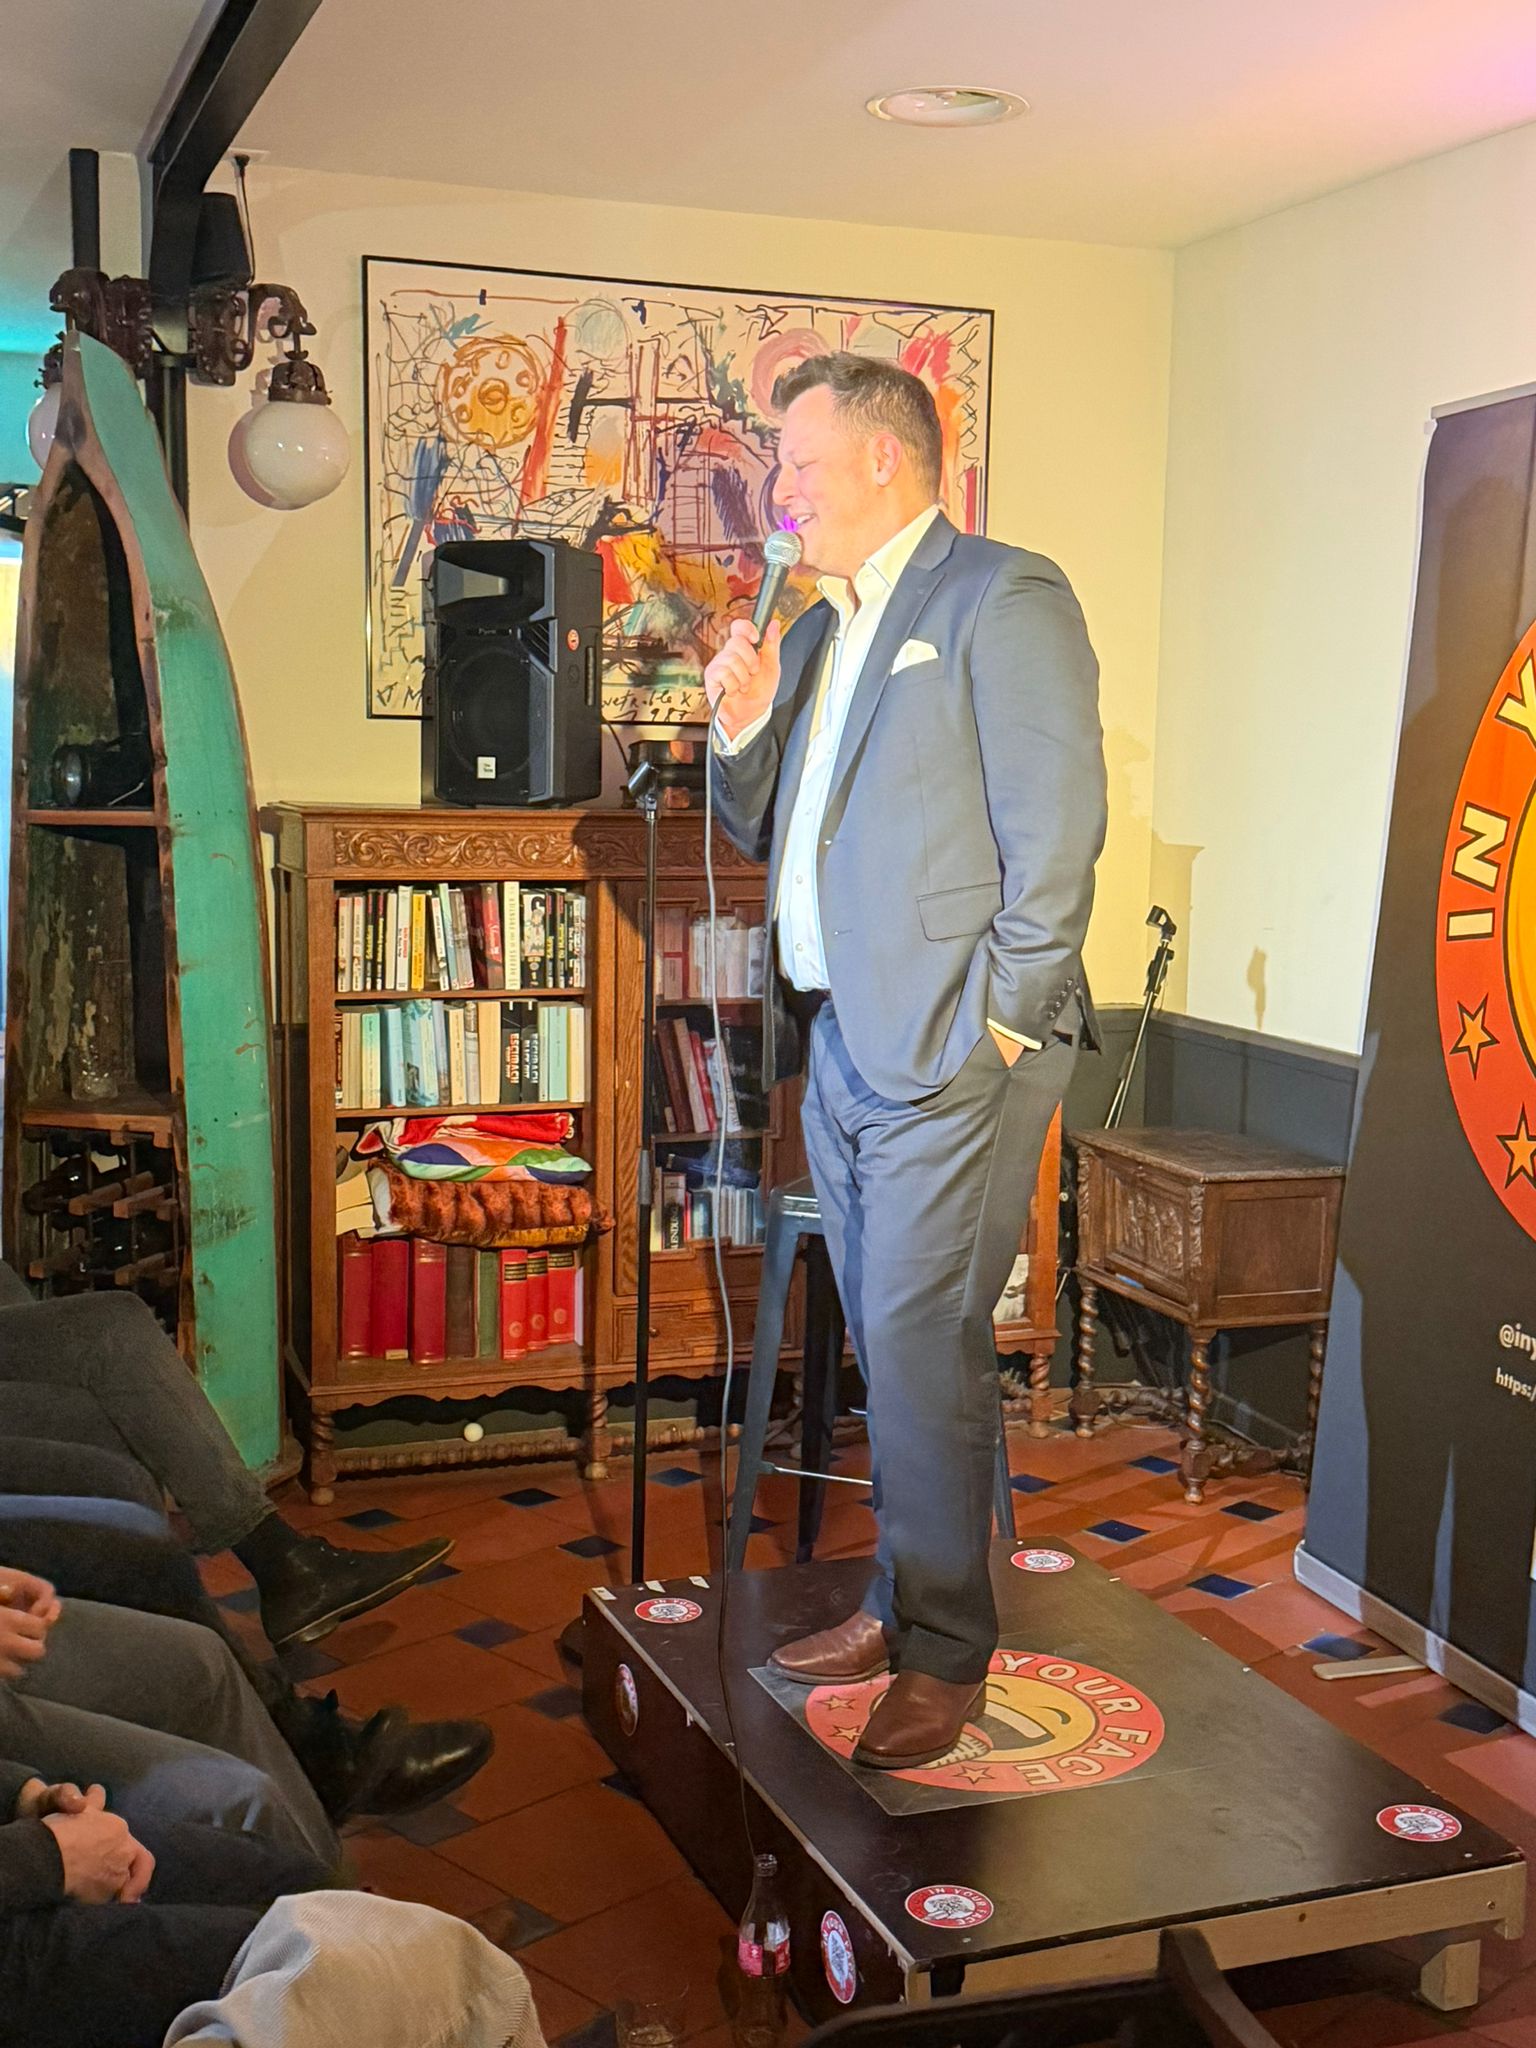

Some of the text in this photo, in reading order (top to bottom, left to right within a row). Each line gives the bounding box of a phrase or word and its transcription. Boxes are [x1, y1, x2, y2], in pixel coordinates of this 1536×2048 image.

[1446, 801, 1511, 941] IN
[998, 1652, 1152, 1786] YOUR FACE
[927, 1887, 945, 1895] IN
[953, 1888, 987, 1907] YOUR
